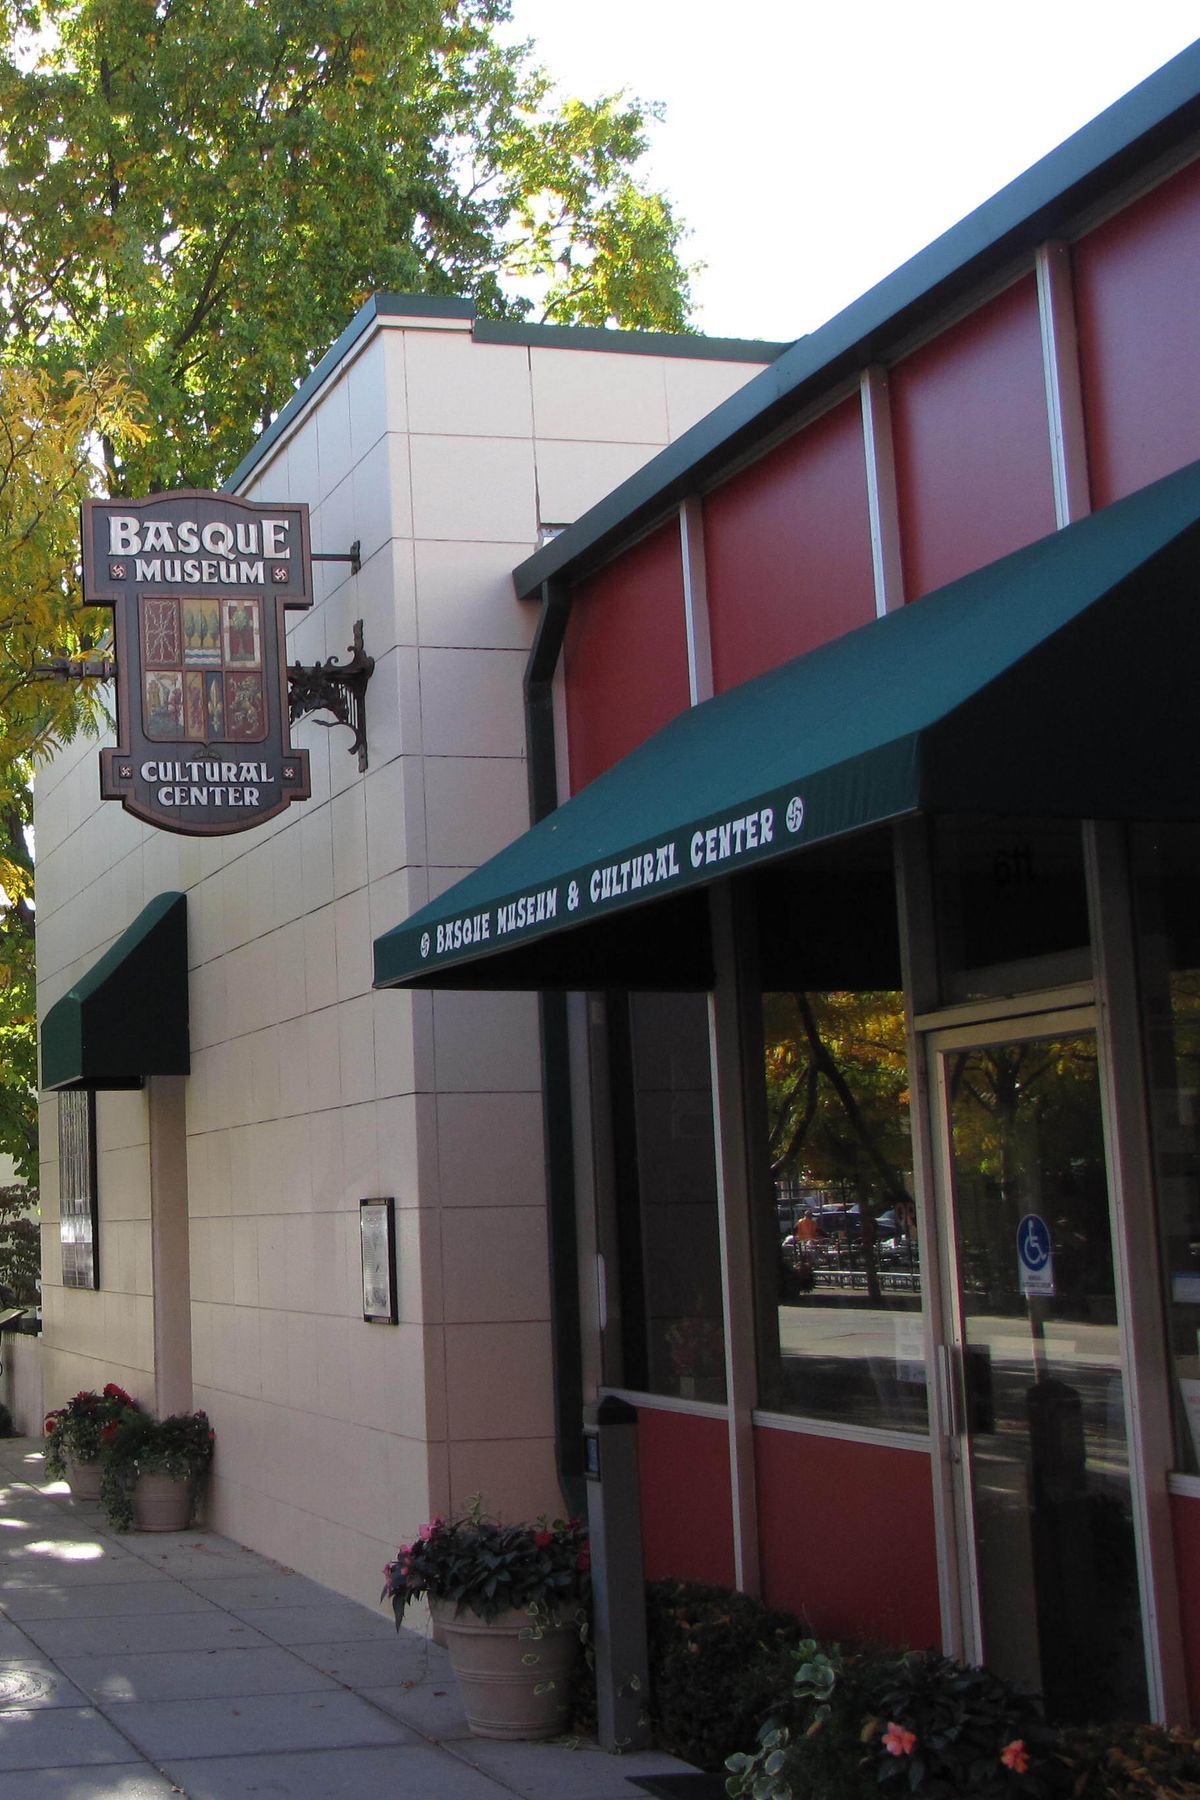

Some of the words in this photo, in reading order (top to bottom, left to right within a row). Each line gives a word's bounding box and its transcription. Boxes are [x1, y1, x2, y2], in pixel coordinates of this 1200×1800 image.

[108, 516, 291, 560] BASQUE
[134, 559, 266, 585] MUSEUM
[140, 761, 275, 783] CULTURAL
[157, 787, 260, 807] CENTER
[436, 912, 490, 954] BASQUE
[497, 887, 557, 935] MUSEUM
[567, 881, 579, 911] &
[590, 843, 680, 902] CULTURAL
[690, 808, 774, 867] CENTER
